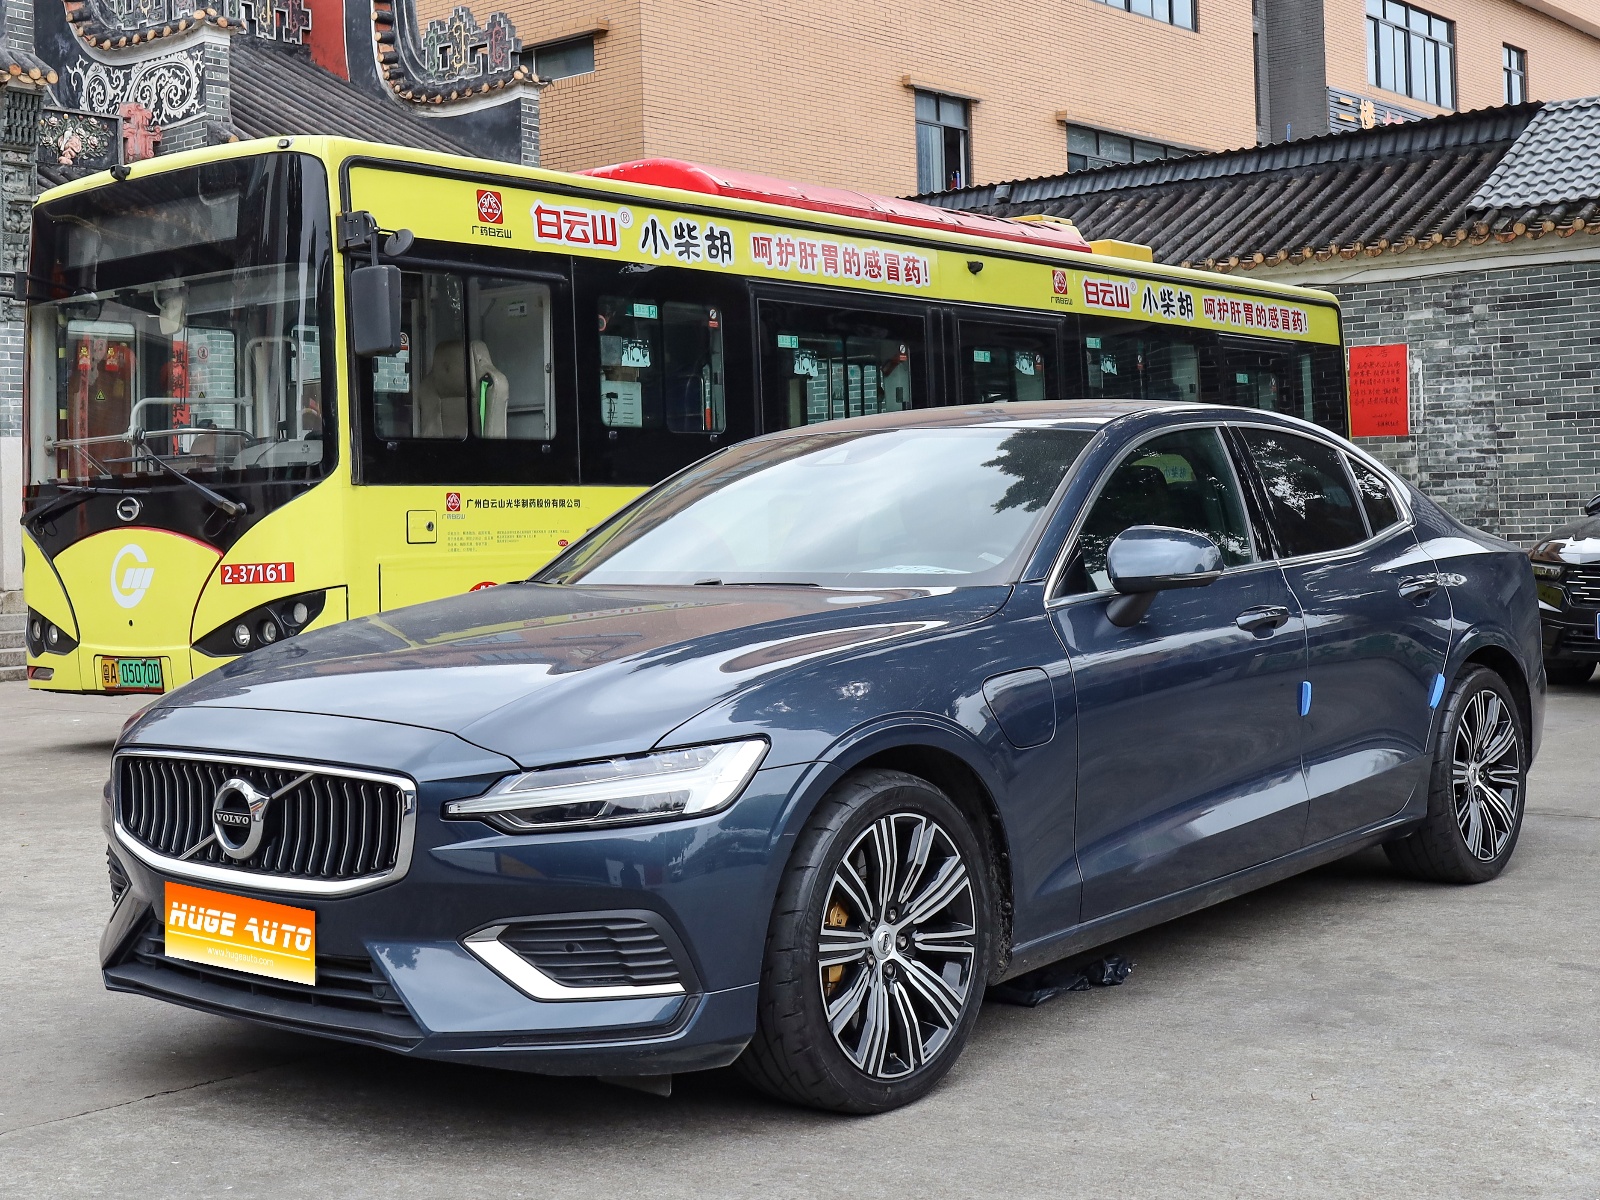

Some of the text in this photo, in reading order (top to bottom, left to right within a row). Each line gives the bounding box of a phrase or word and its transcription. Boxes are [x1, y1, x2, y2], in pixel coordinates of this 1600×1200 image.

[471, 225, 512, 239] 广药白云山
[641, 218, 732, 264] 小柴胡
[752, 236, 929, 285] 呵护肝胃的感冒药!
[1142, 287, 1194, 320] 小柴胡
[466, 498, 581, 509] 广州白云山光华制药股份有限公司
[223, 563, 287, 583] 2-37161
[216, 812, 249, 825] VOLVO
